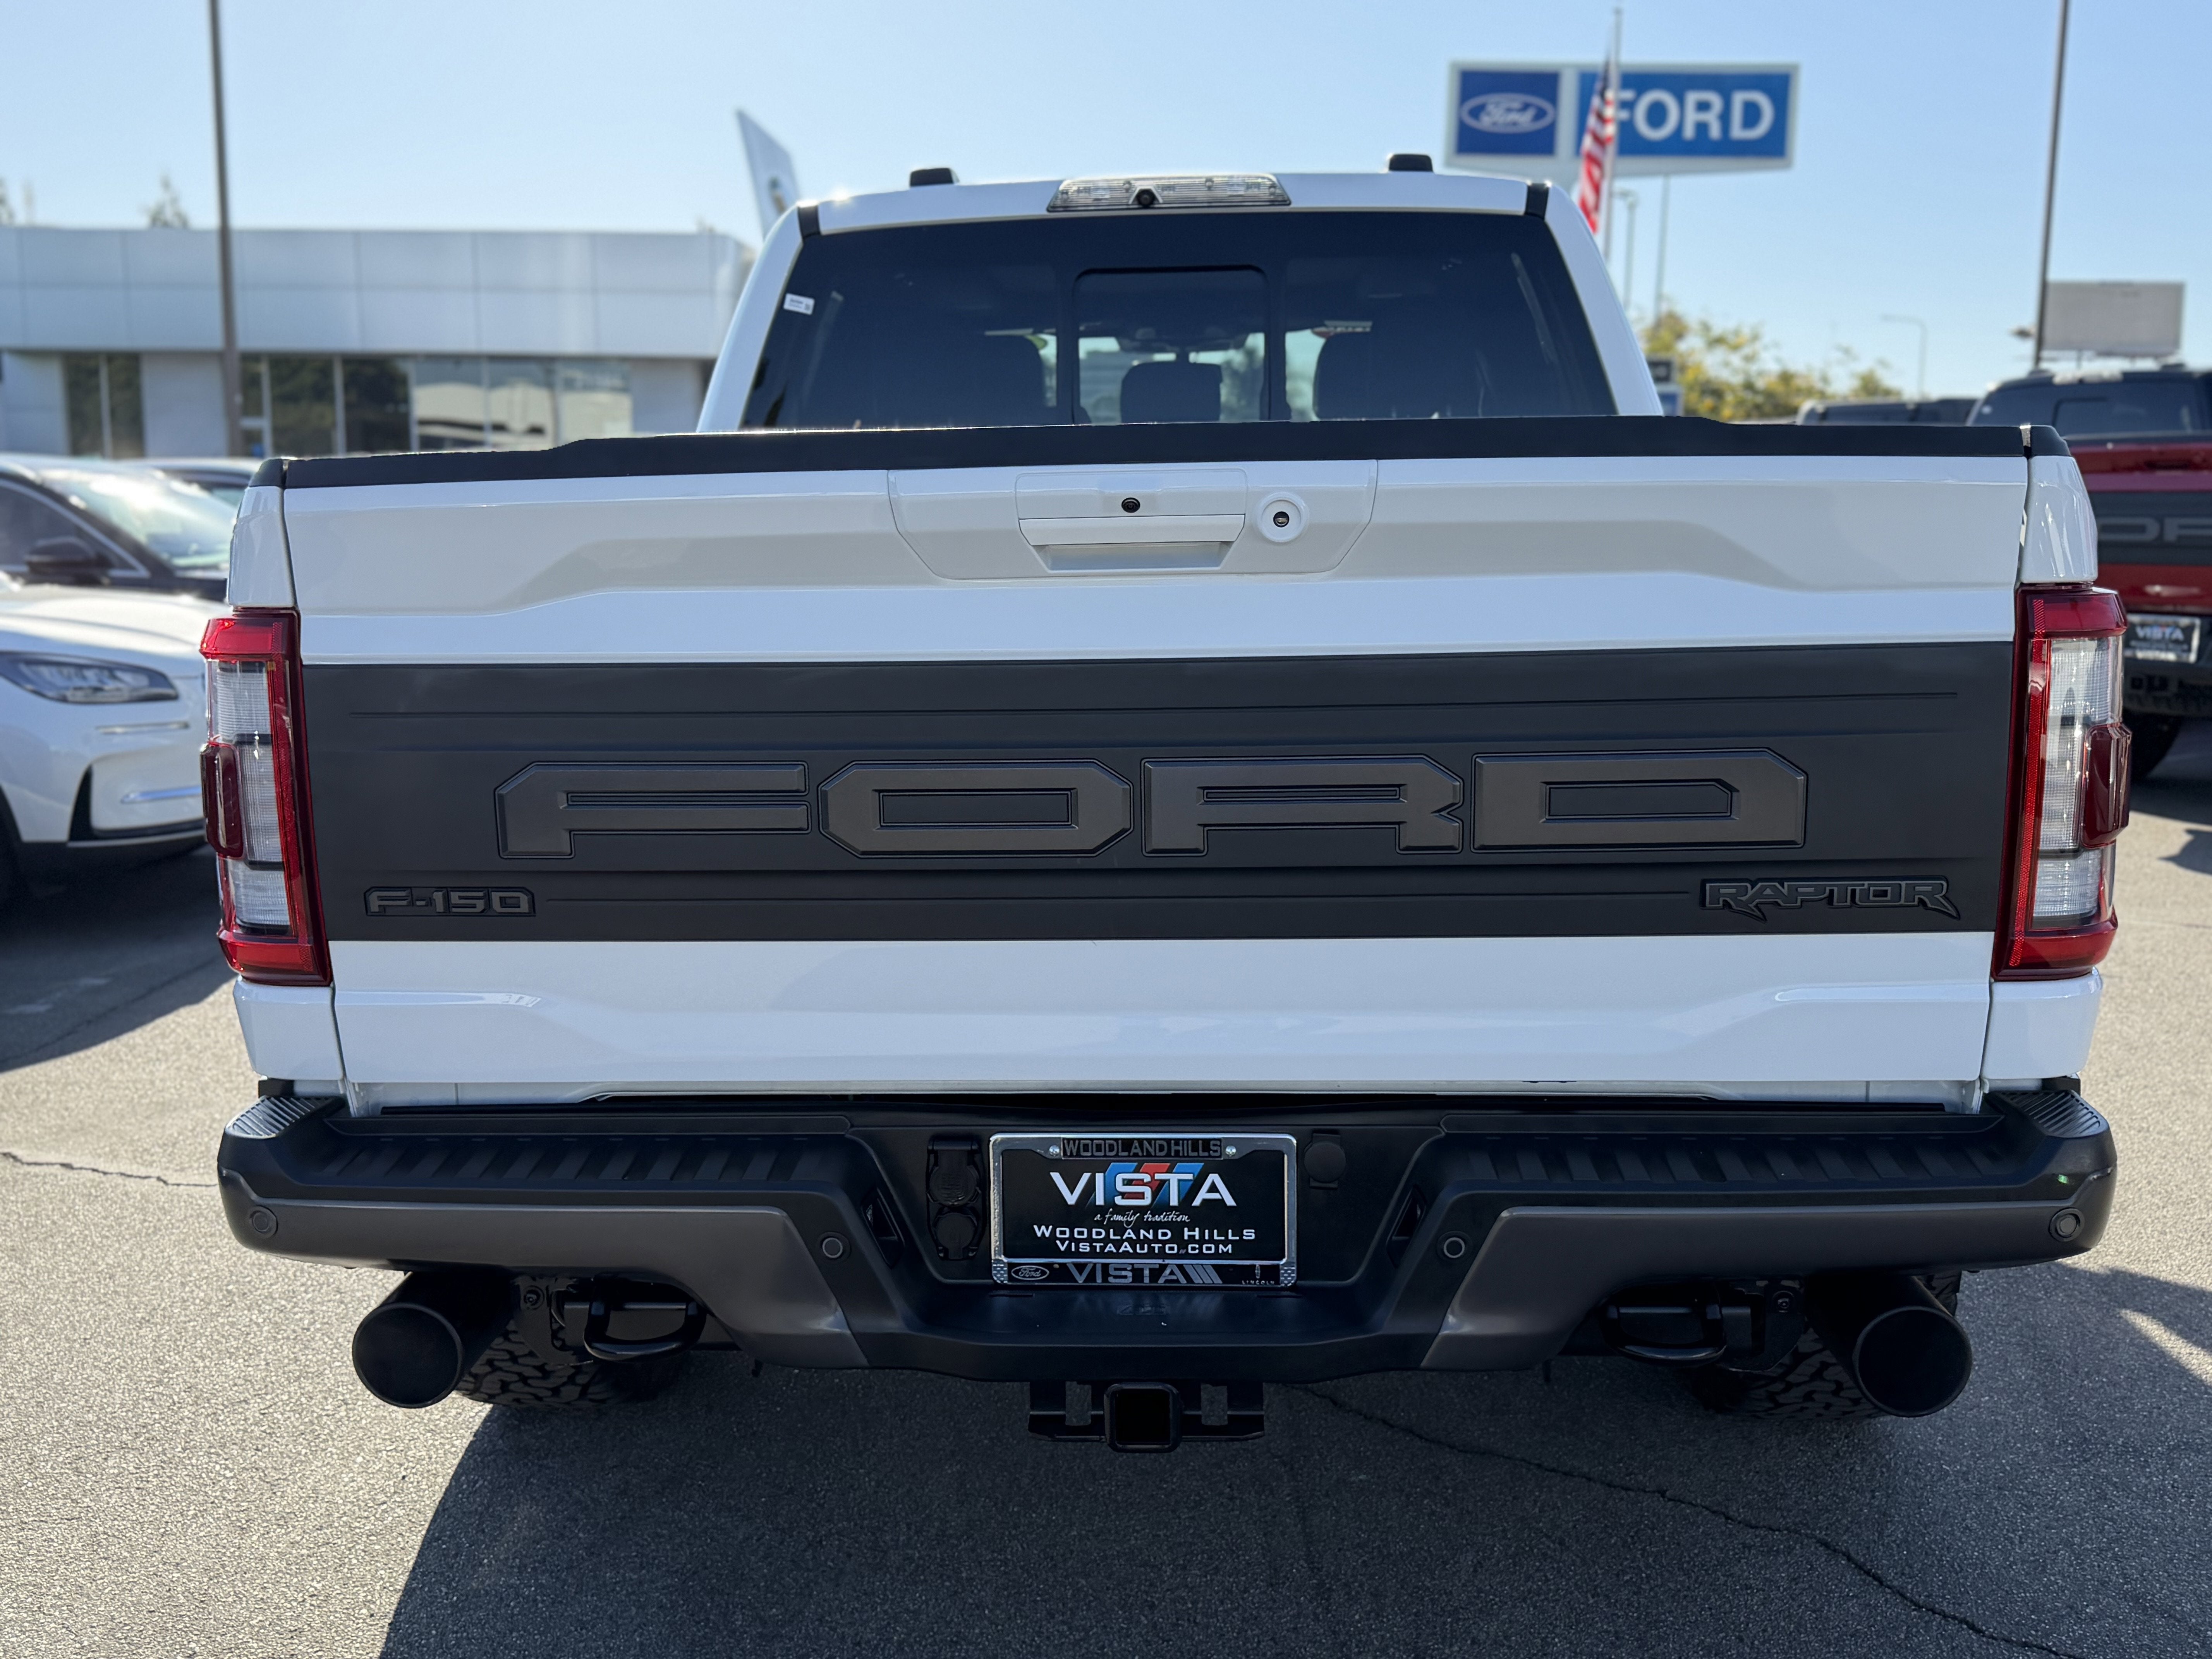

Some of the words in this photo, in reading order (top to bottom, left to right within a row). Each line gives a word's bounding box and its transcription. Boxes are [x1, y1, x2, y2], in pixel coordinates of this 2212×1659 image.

[1479, 98, 1537, 127] Ford
[495, 748, 1808, 859] FORD
[368, 890, 532, 913] F-150
[1704, 880, 1961, 923] RAPTOR
[1063, 1140, 1168, 1157] WOODLAND
[1171, 1140, 1221, 1157] HILLS
[1050, 1172, 1237, 1207] VISTA
[1103, 1208, 1140, 1228] family
[1144, 1211, 1190, 1222] tradition
[1018, 1267, 1042, 1277] Ford
[1066, 1263, 1186, 1284] VISTA
